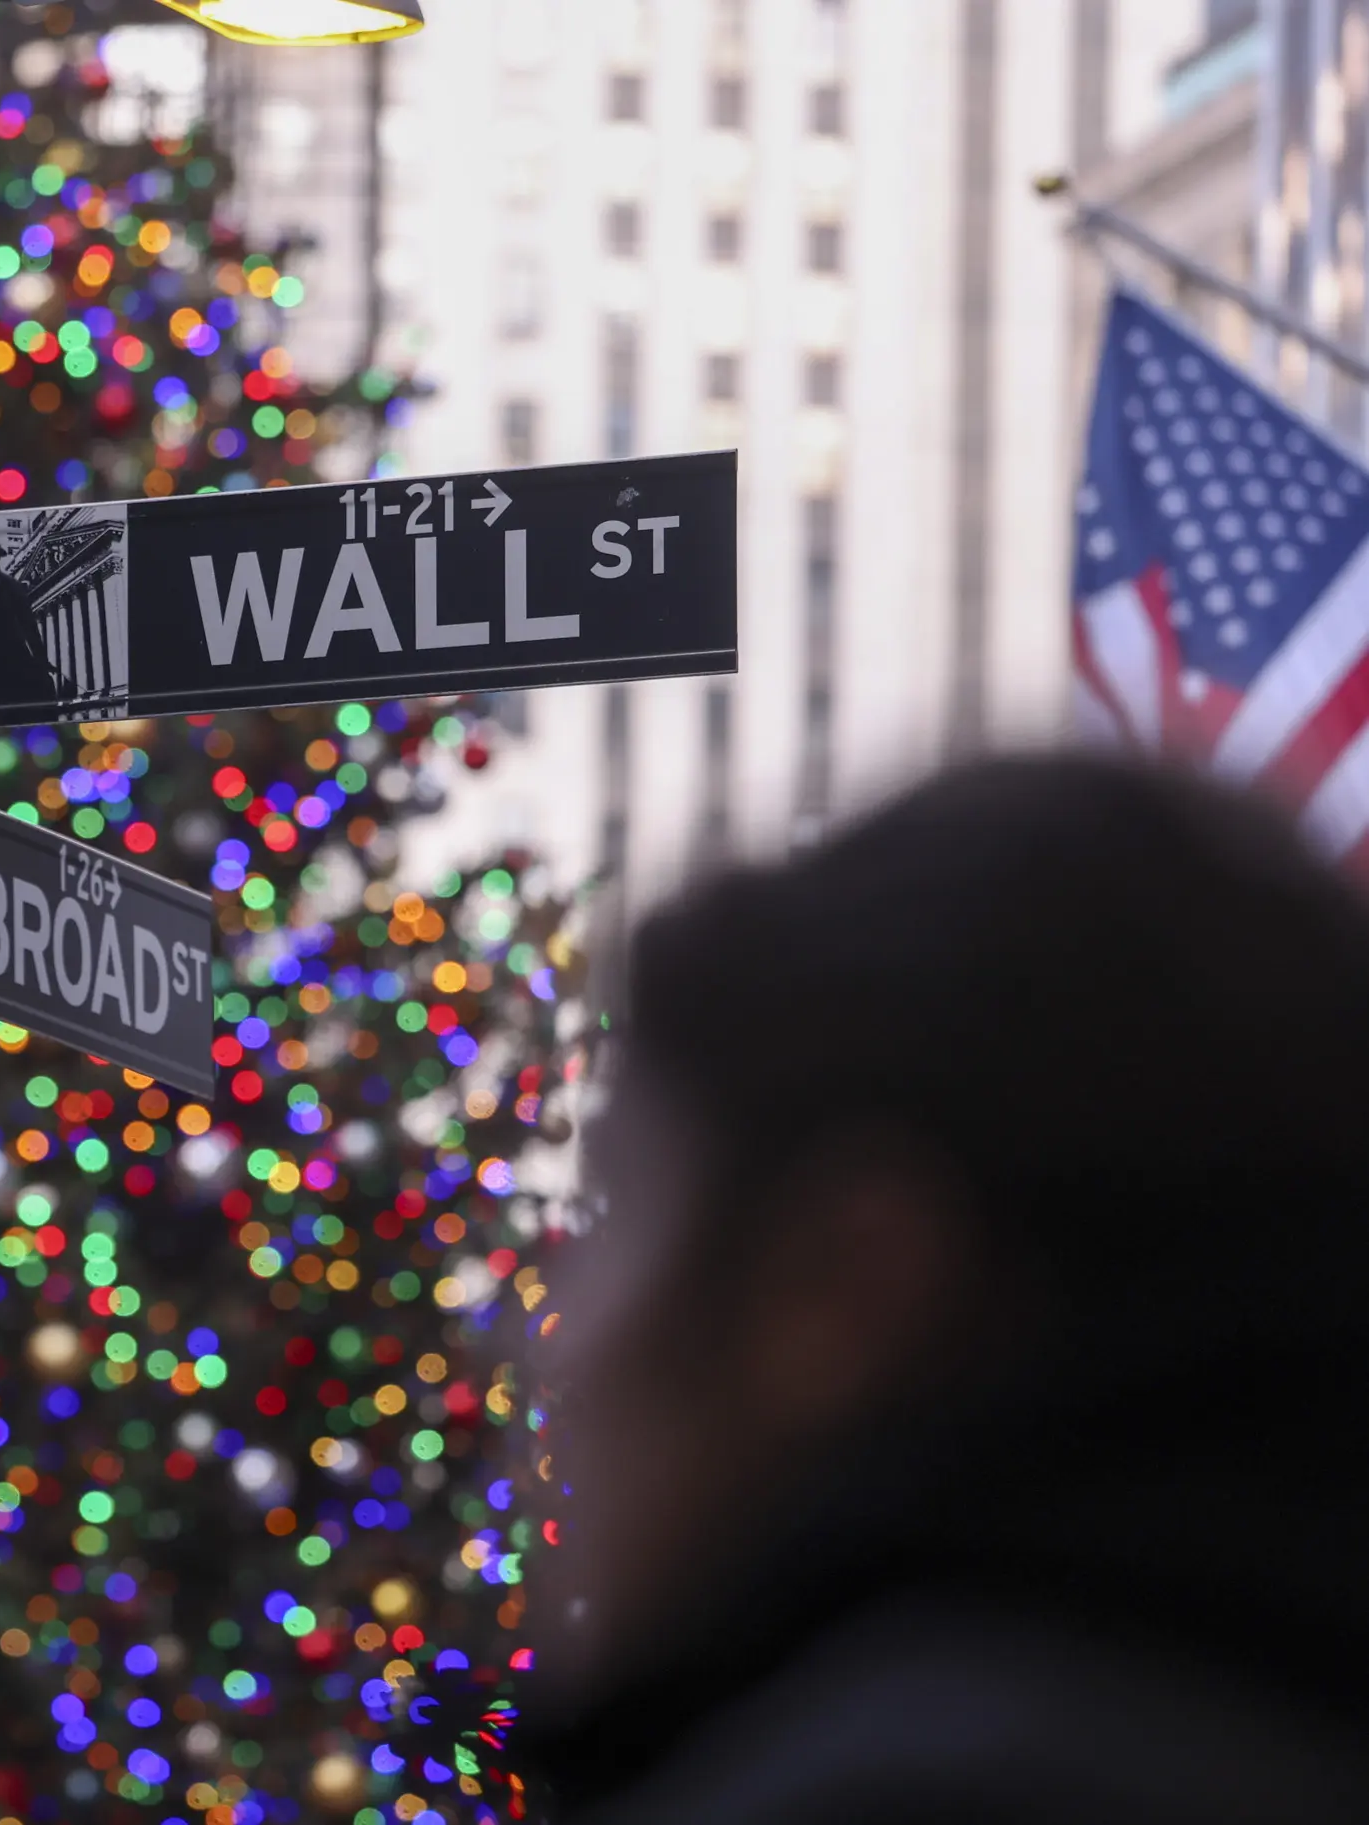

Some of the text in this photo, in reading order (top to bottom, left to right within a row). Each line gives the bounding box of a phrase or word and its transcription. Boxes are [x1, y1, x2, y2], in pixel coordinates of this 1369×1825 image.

[339, 480, 456, 540] 11-21
[189, 515, 680, 667] WALL ST
[60, 844, 103, 906] 1-26
[172, 941, 207, 1002] ST
